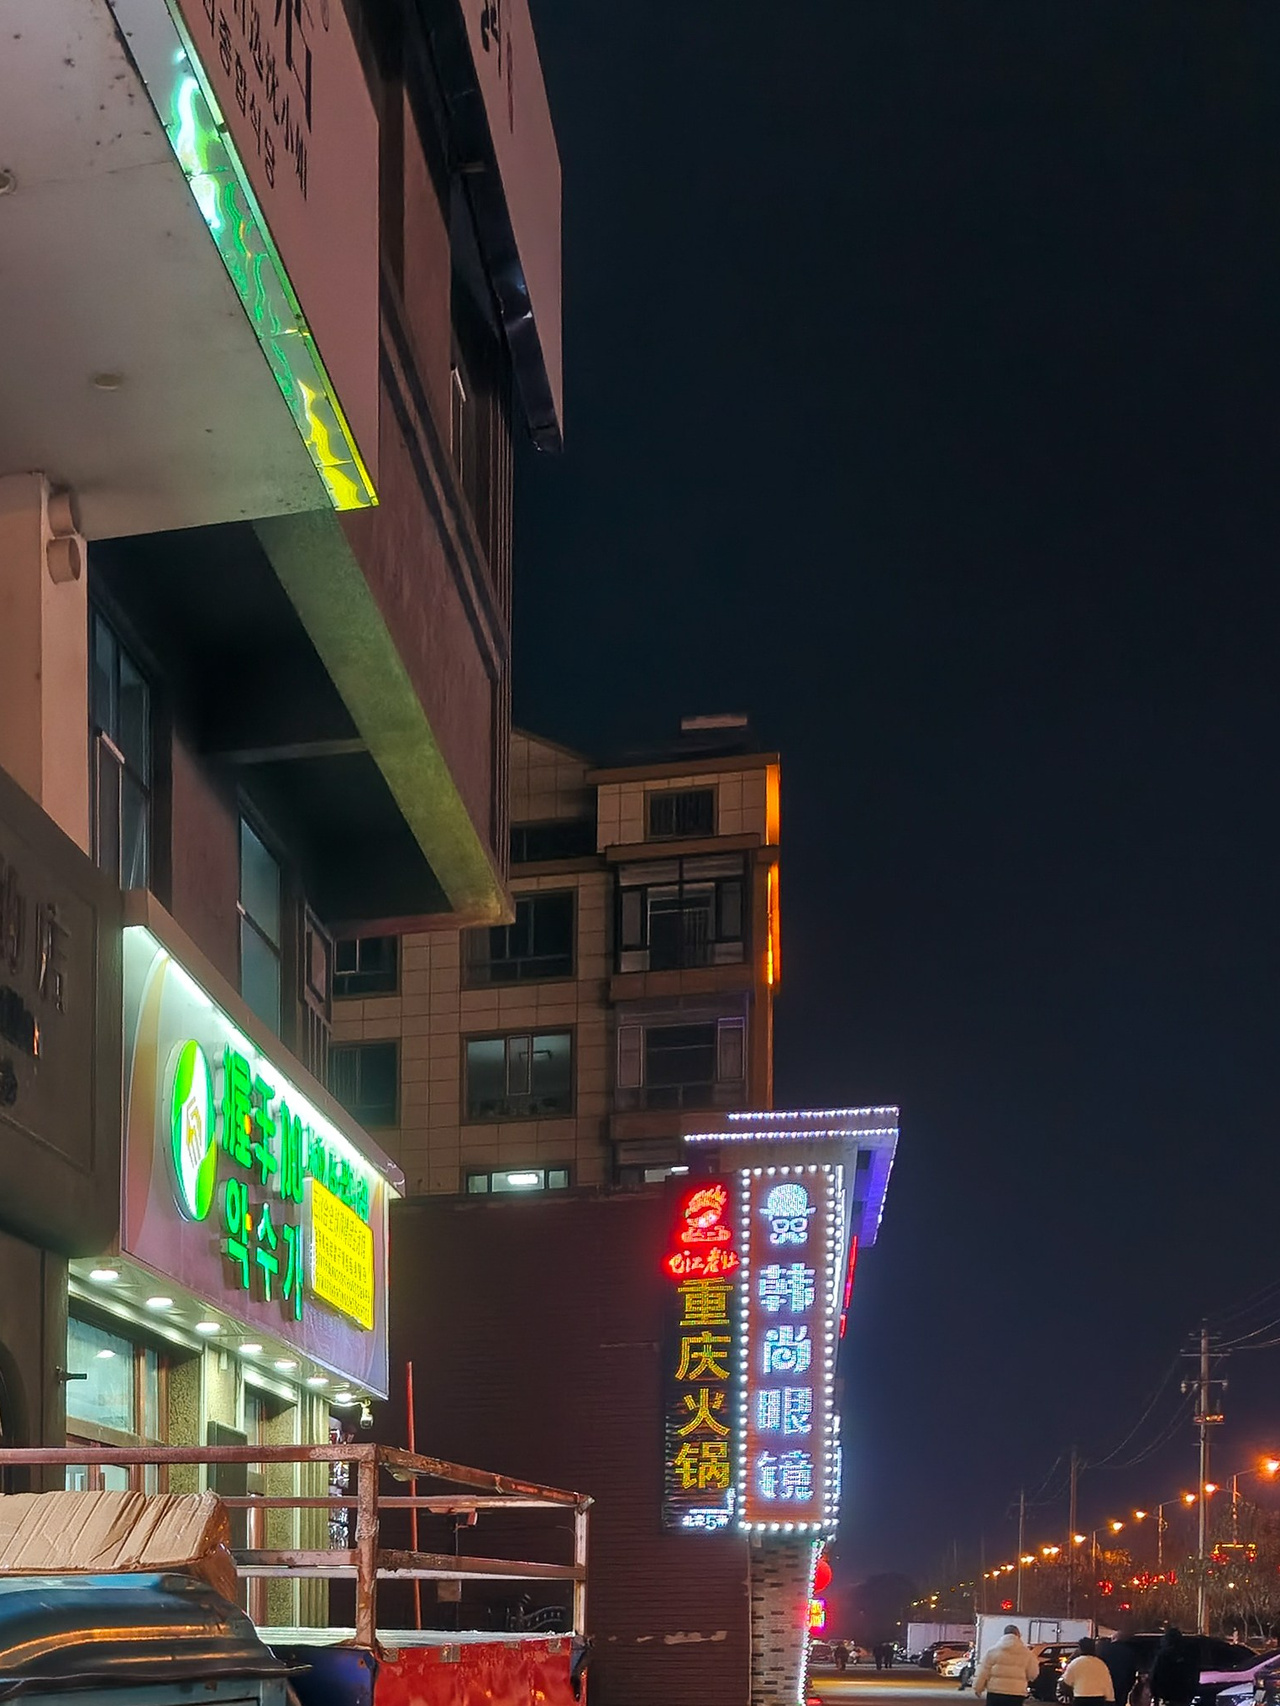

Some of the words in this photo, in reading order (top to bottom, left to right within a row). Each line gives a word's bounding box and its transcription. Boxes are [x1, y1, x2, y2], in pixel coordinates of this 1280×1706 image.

[674, 1276, 734, 1490] 重庆火锅
[758, 1263, 816, 1500] 韩尚眼镜
